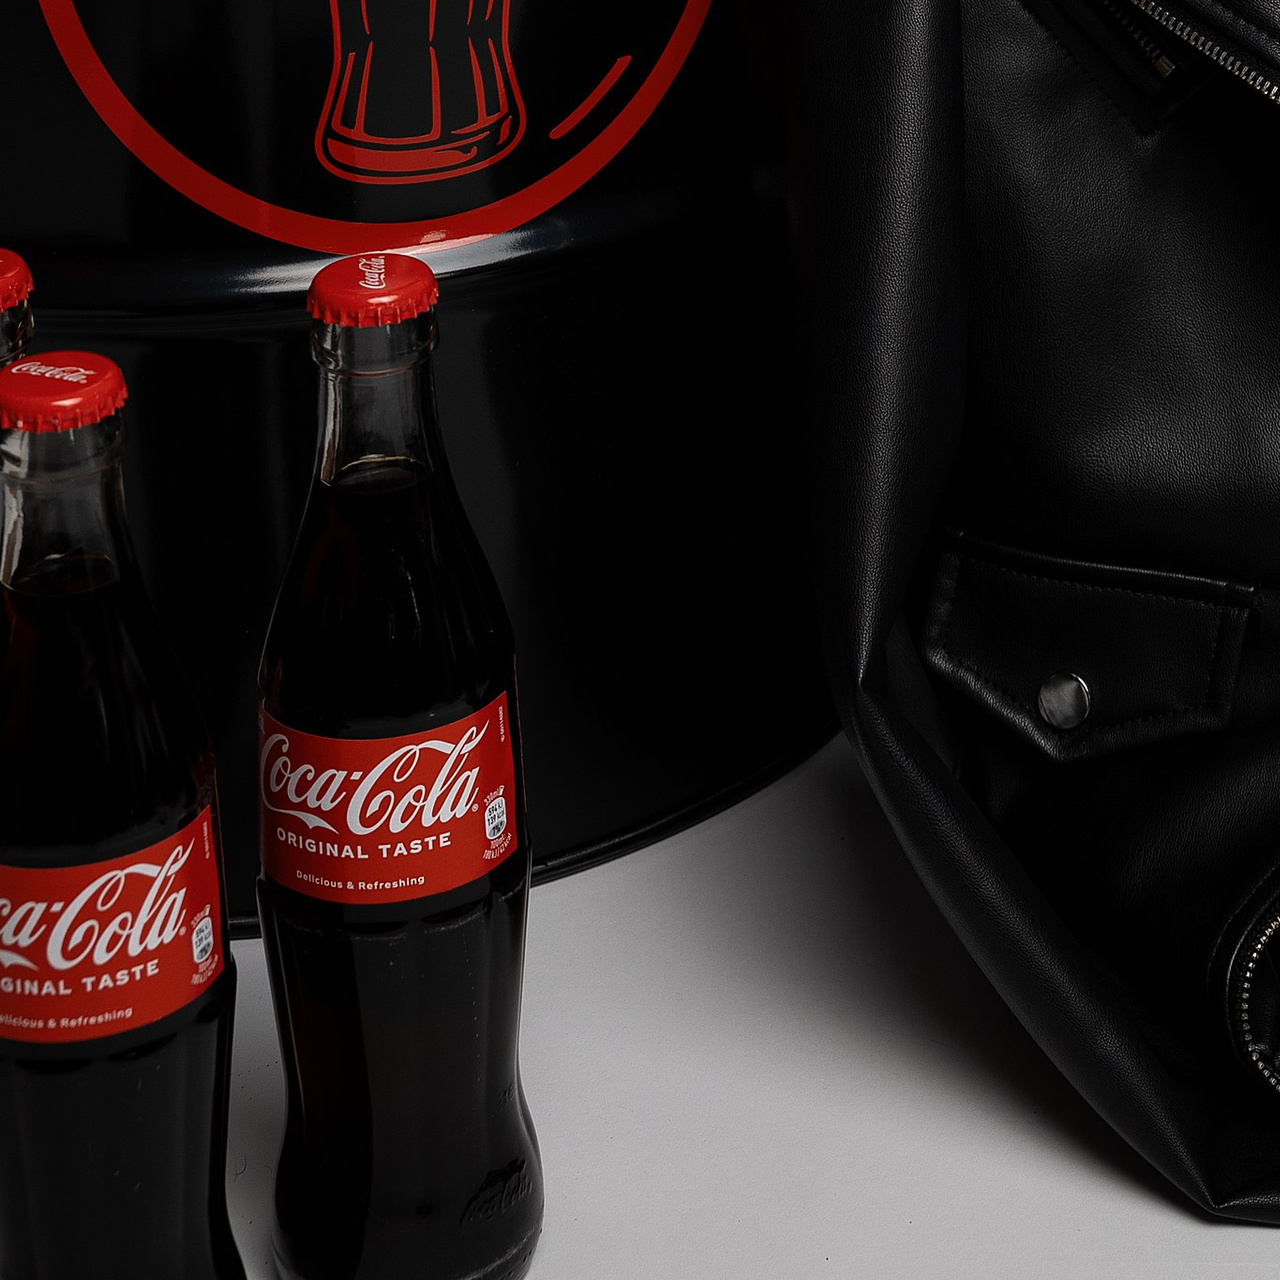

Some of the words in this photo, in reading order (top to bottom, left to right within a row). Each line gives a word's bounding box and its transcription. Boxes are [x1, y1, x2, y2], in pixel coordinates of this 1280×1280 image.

[359, 256, 386, 289] Coca-Cola
[11, 361, 97, 383] Coca-Cola
[261, 719, 490, 835] Coca-Cola
[276, 827, 369, 859] ORIGINAL
[378, 831, 451, 859] TASTE
[296, 870, 343, 889] Delicious
[346, 881, 354, 890] &
[358, 875, 425, 890] Refreshing
[0, 977, 72, 996] GINAL
[81, 958, 160, 992] TASTE
[0, 1013, 44, 1029] elicious
[47, 1018, 57, 1029] &
[60, 1007, 134, 1028] Refreshing
